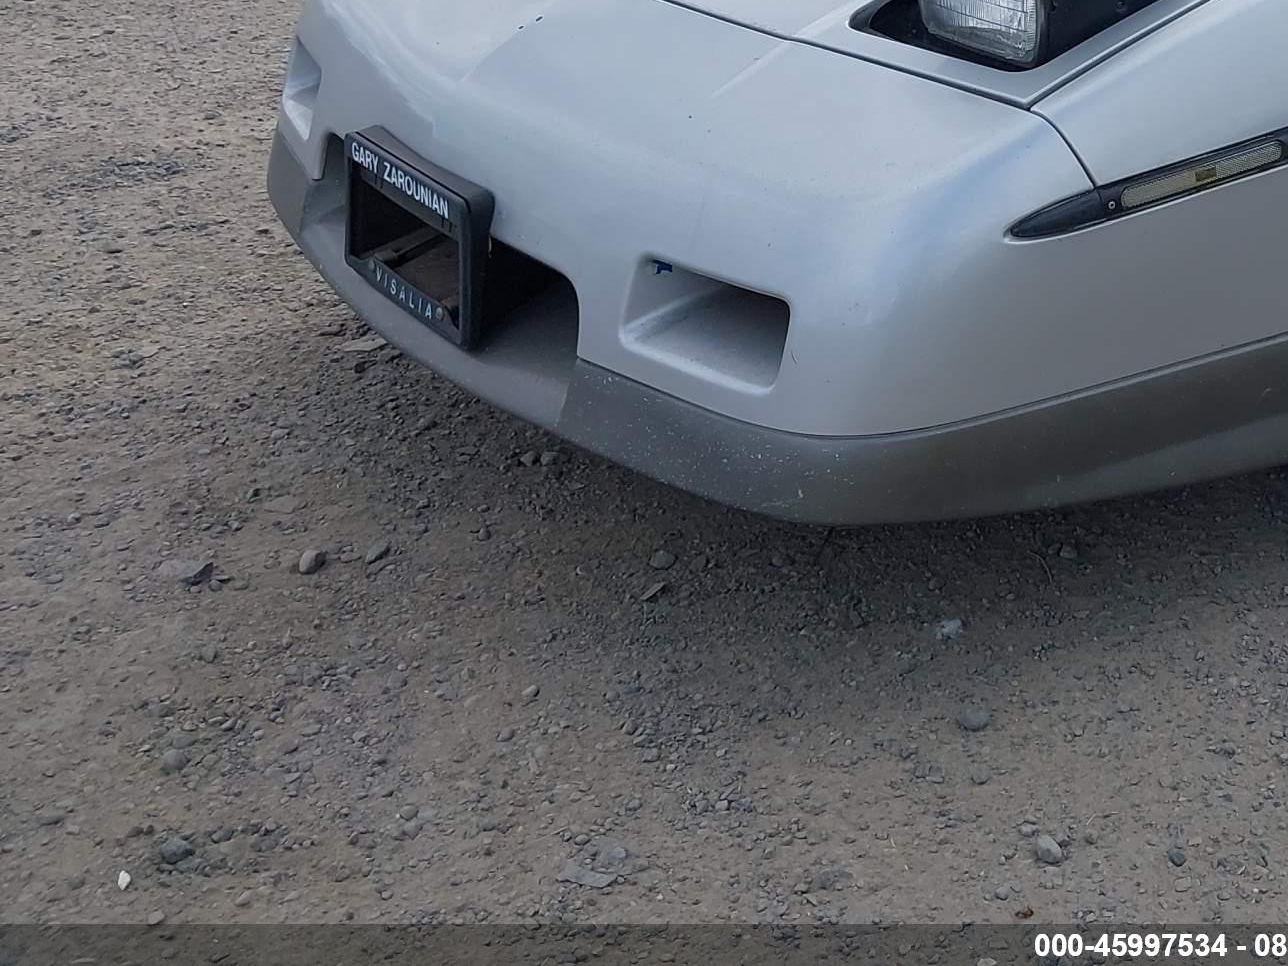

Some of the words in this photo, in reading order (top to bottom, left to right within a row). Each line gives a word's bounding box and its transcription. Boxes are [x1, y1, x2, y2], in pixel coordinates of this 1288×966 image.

[352, 142, 379, 174] GARY
[383, 160, 449, 220] ZAROUNIAN
[375, 265, 433, 320] VISALIA
